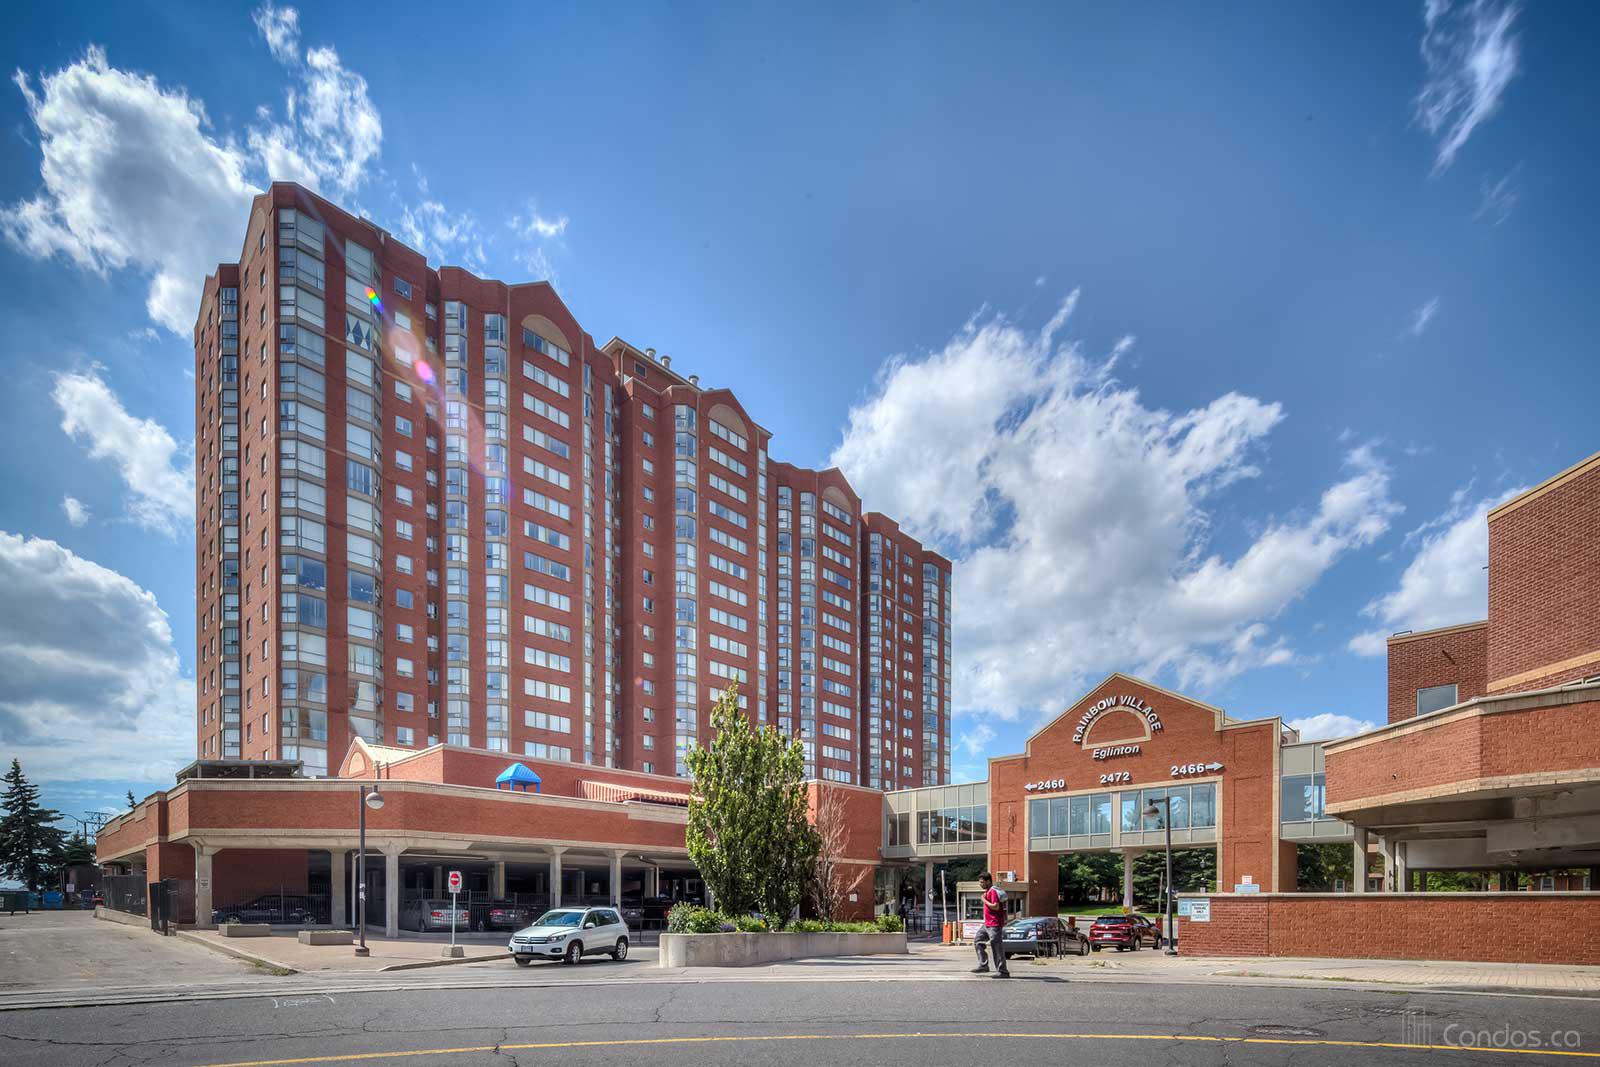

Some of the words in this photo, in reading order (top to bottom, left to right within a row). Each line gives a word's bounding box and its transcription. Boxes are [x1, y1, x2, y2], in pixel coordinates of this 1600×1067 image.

[1072, 695, 1117, 743] RAINBOW
[1120, 695, 1162, 732] VILLAGE
[1092, 744, 1140, 760] Eglinton
[1171, 763, 1205, 776] 2466
[1100, 771, 1130, 784] 2472
[1037, 779, 1065, 791] 2460
